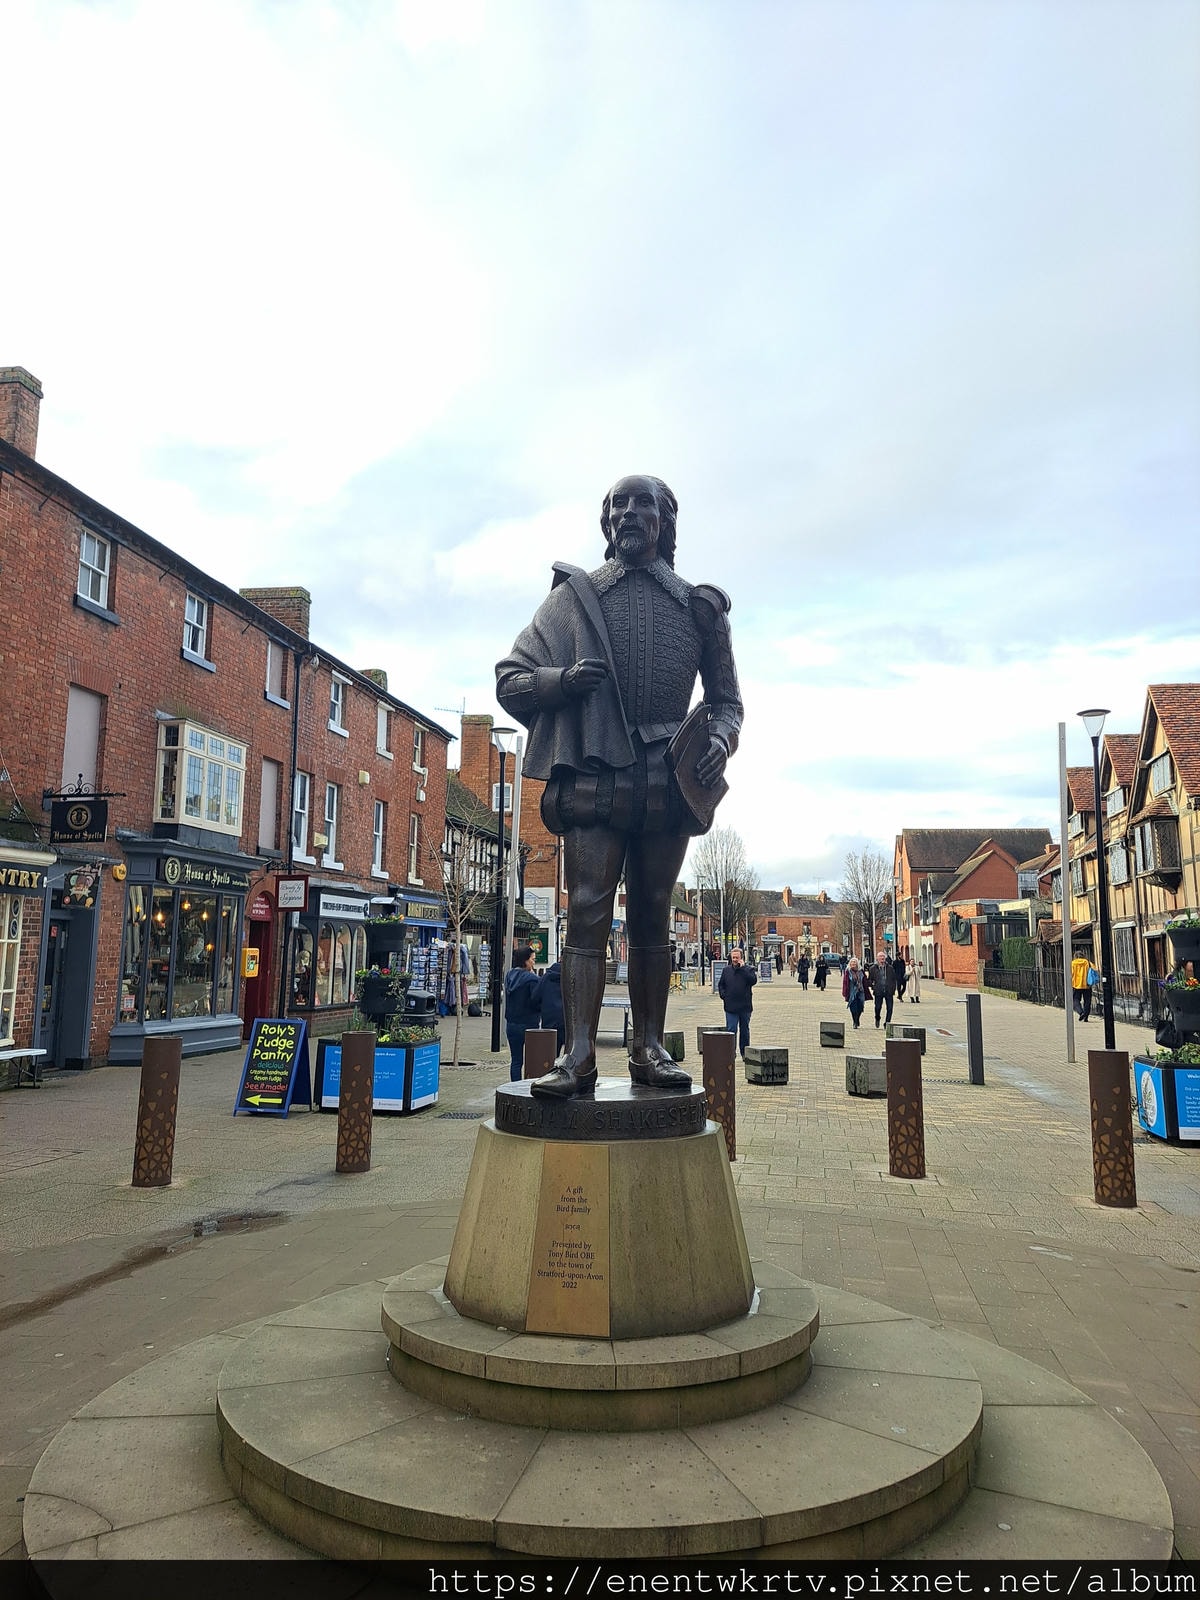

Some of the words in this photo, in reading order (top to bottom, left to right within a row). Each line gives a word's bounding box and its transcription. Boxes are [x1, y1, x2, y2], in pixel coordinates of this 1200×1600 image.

[184, 861, 204, 884] House
[204, 870, 211, 881] of
[211, 866, 231, 888] Spells
[261, 1024, 295, 1037] Roly's
[256, 1036, 295, 1050] Fudge
[253, 1049, 294, 1062] Pantry
[244, 1082, 258, 1090] See
[572, 1186, 583, 1195] gift
[560, 1194, 576, 1203] from
[577, 1195, 588, 1203] the
[556, 1204, 570, 1212] Bird
[570, 1205, 592, 1215] family
[552, 1240, 583, 1249] Presented
[583, 1241, 592, 1251] by
[548, 1250, 564, 1260] Tony
[565, 1251, 579, 1259] Bird
[548, 1260, 556, 1268] to
[568, 1261, 584, 1269] town
[585, 1262, 594, 1270] of
[537, 1269, 604, 1280] Stratford-upon-Avon
[562, 1281, 578, 1289] 2022
